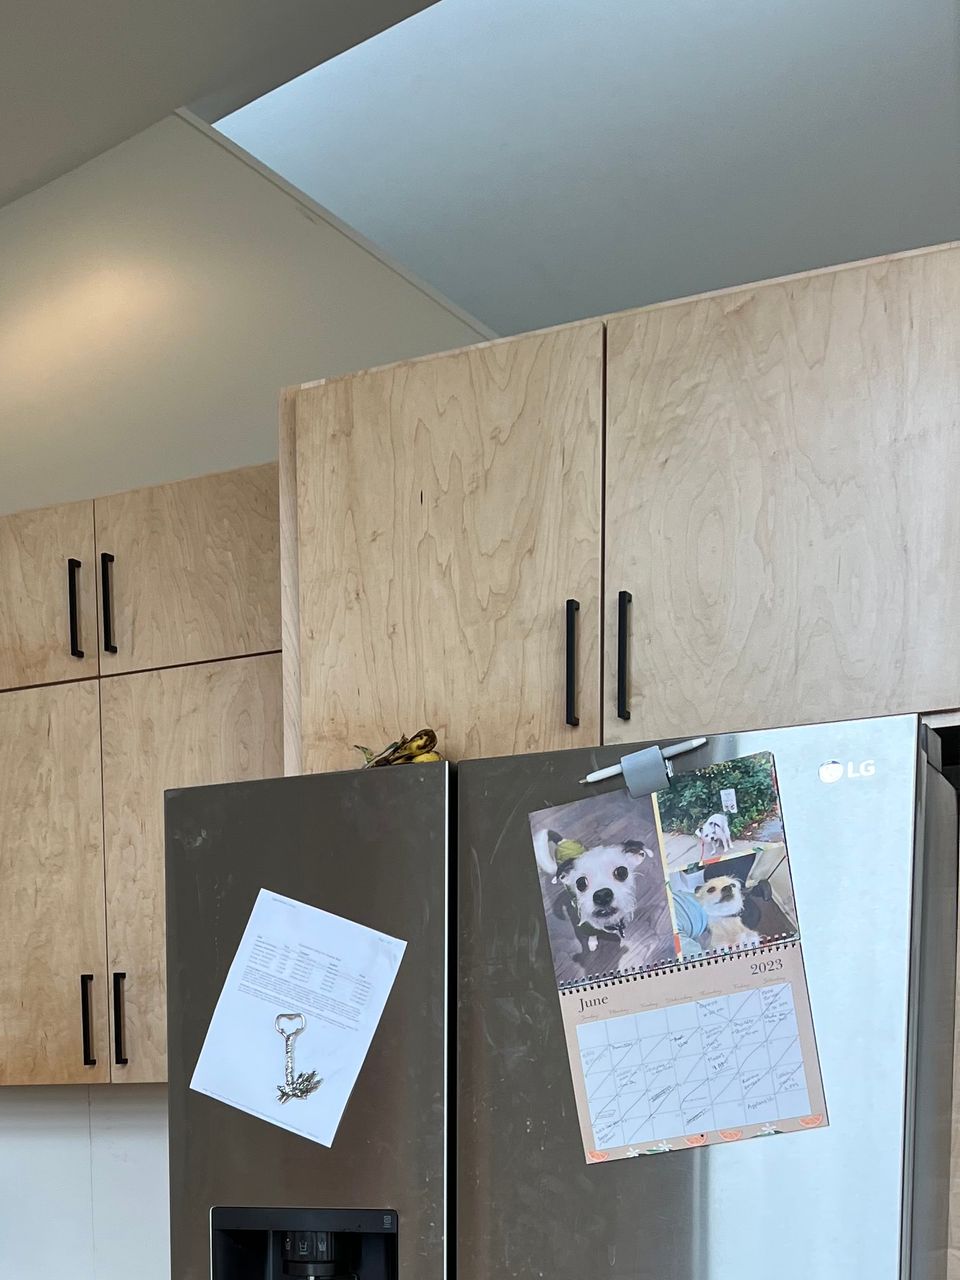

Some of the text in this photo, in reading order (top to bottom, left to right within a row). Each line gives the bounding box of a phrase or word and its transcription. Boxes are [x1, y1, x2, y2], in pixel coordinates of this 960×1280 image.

[847, 760, 876, 778] LG
[750, 958, 783, 975] 2023
[578, 996, 609, 1013] June
